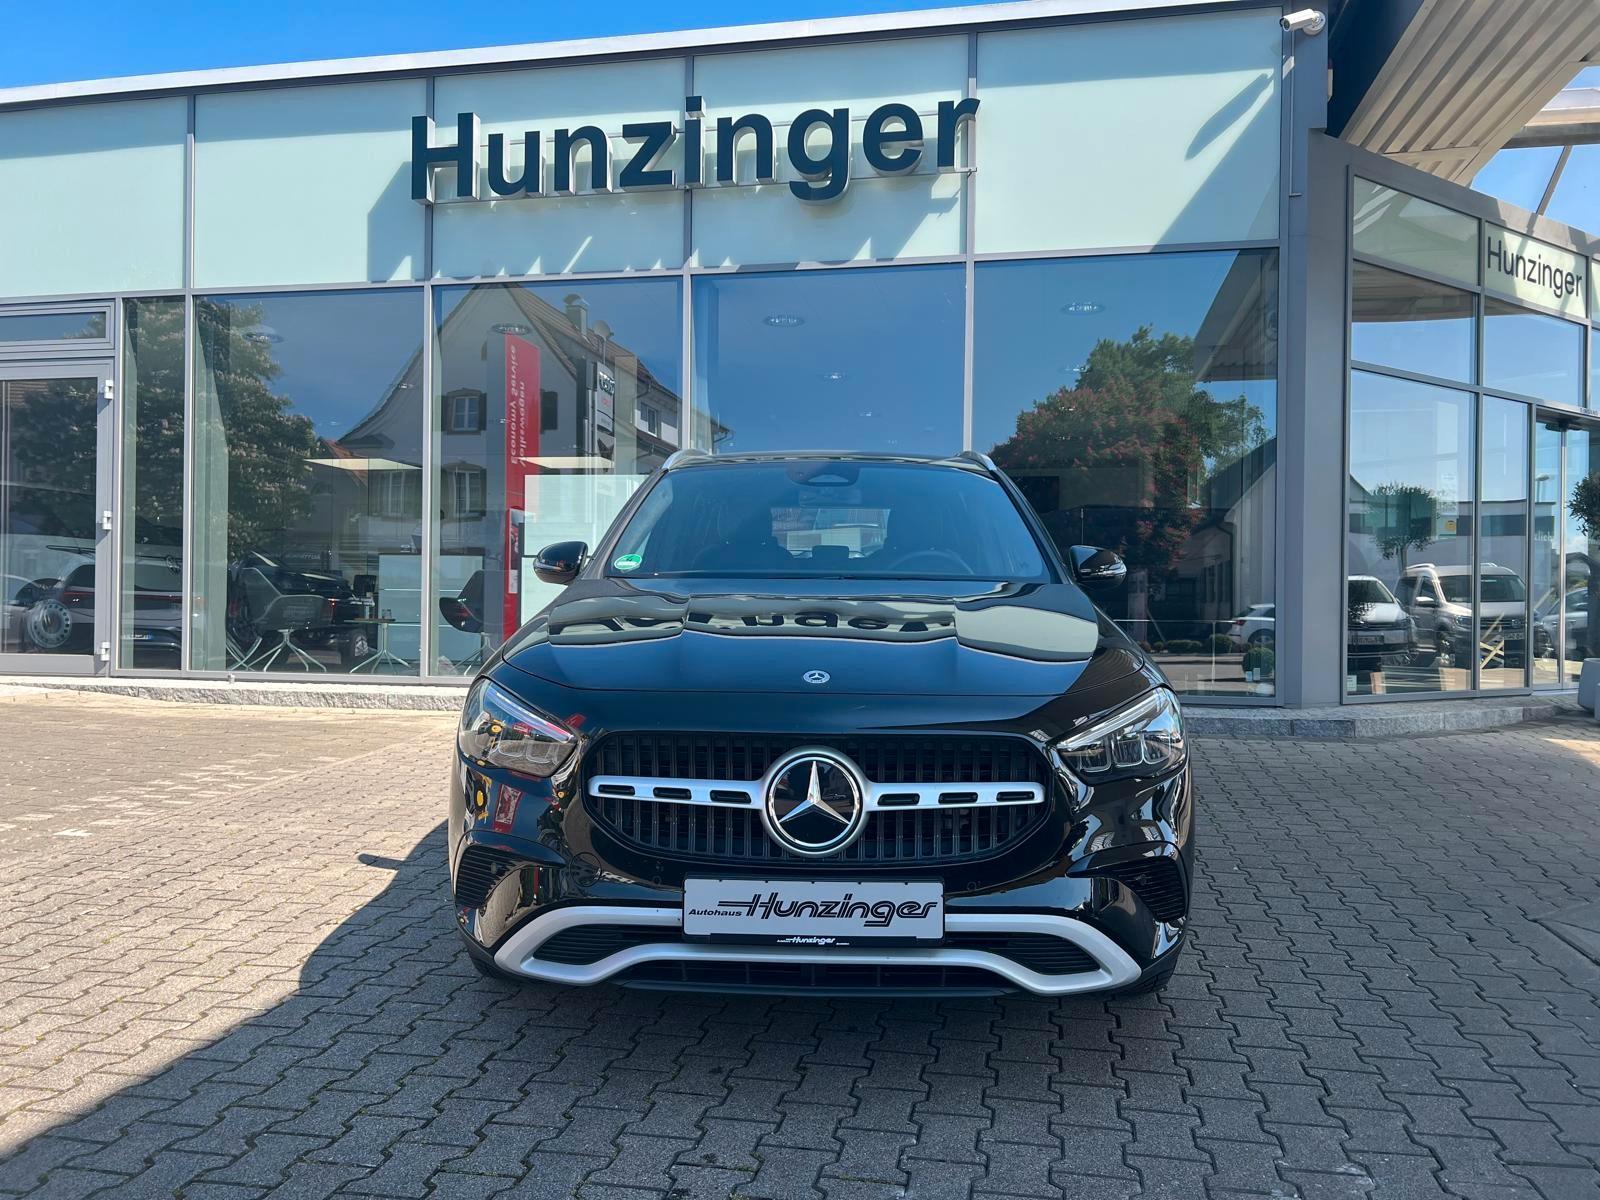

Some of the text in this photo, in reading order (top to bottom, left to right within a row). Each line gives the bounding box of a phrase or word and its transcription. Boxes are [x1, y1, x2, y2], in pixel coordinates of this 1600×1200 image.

[411, 95, 981, 206] Hunzinger
[1487, 236, 1583, 299] Hunzinger
[687, 891, 938, 928] Autohaus Hunzinger
[786, 936, 836, 946] Hunzinger
